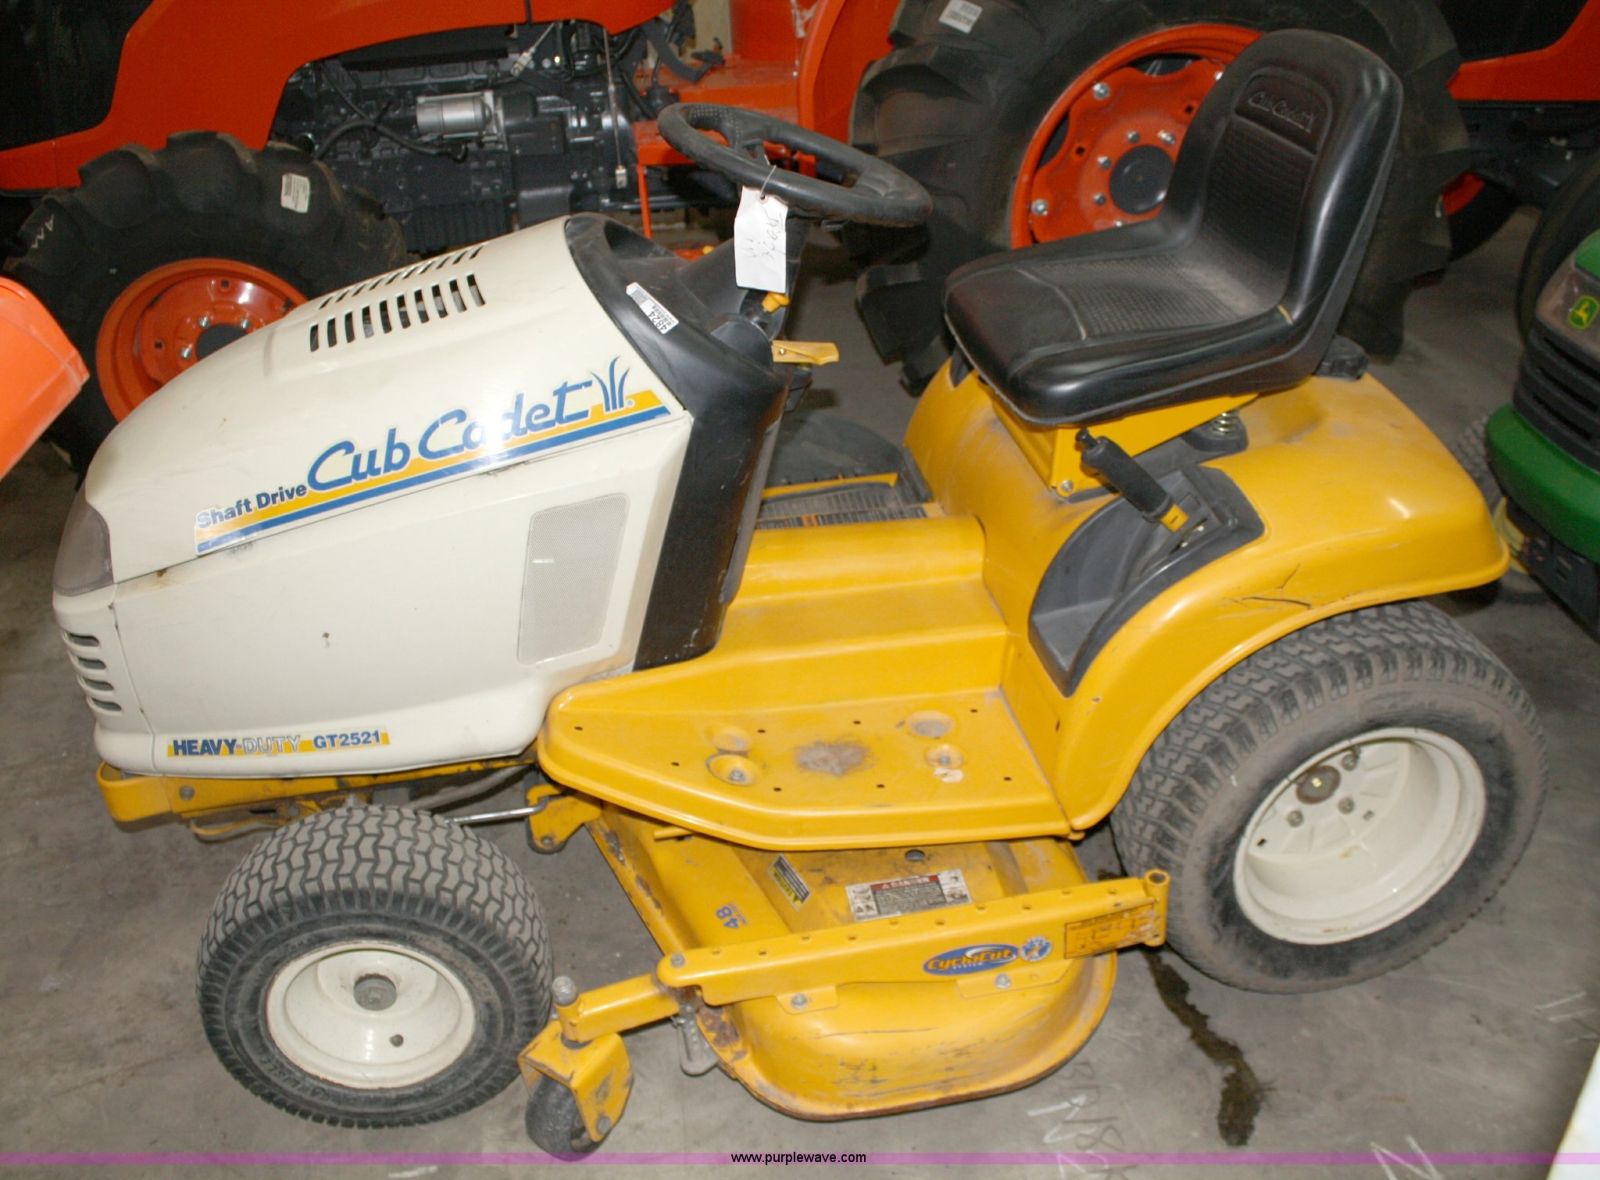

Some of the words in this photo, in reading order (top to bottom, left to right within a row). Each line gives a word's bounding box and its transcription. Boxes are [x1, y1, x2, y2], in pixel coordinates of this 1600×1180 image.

[306, 427, 411, 491] Cub
[418, 380, 594, 462] Cadet
[197, 498, 253, 528] Shaft
[255, 483, 308, 509] Drive
[313, 730, 381, 749] GT2521
[715, 904, 739, 929] 48
